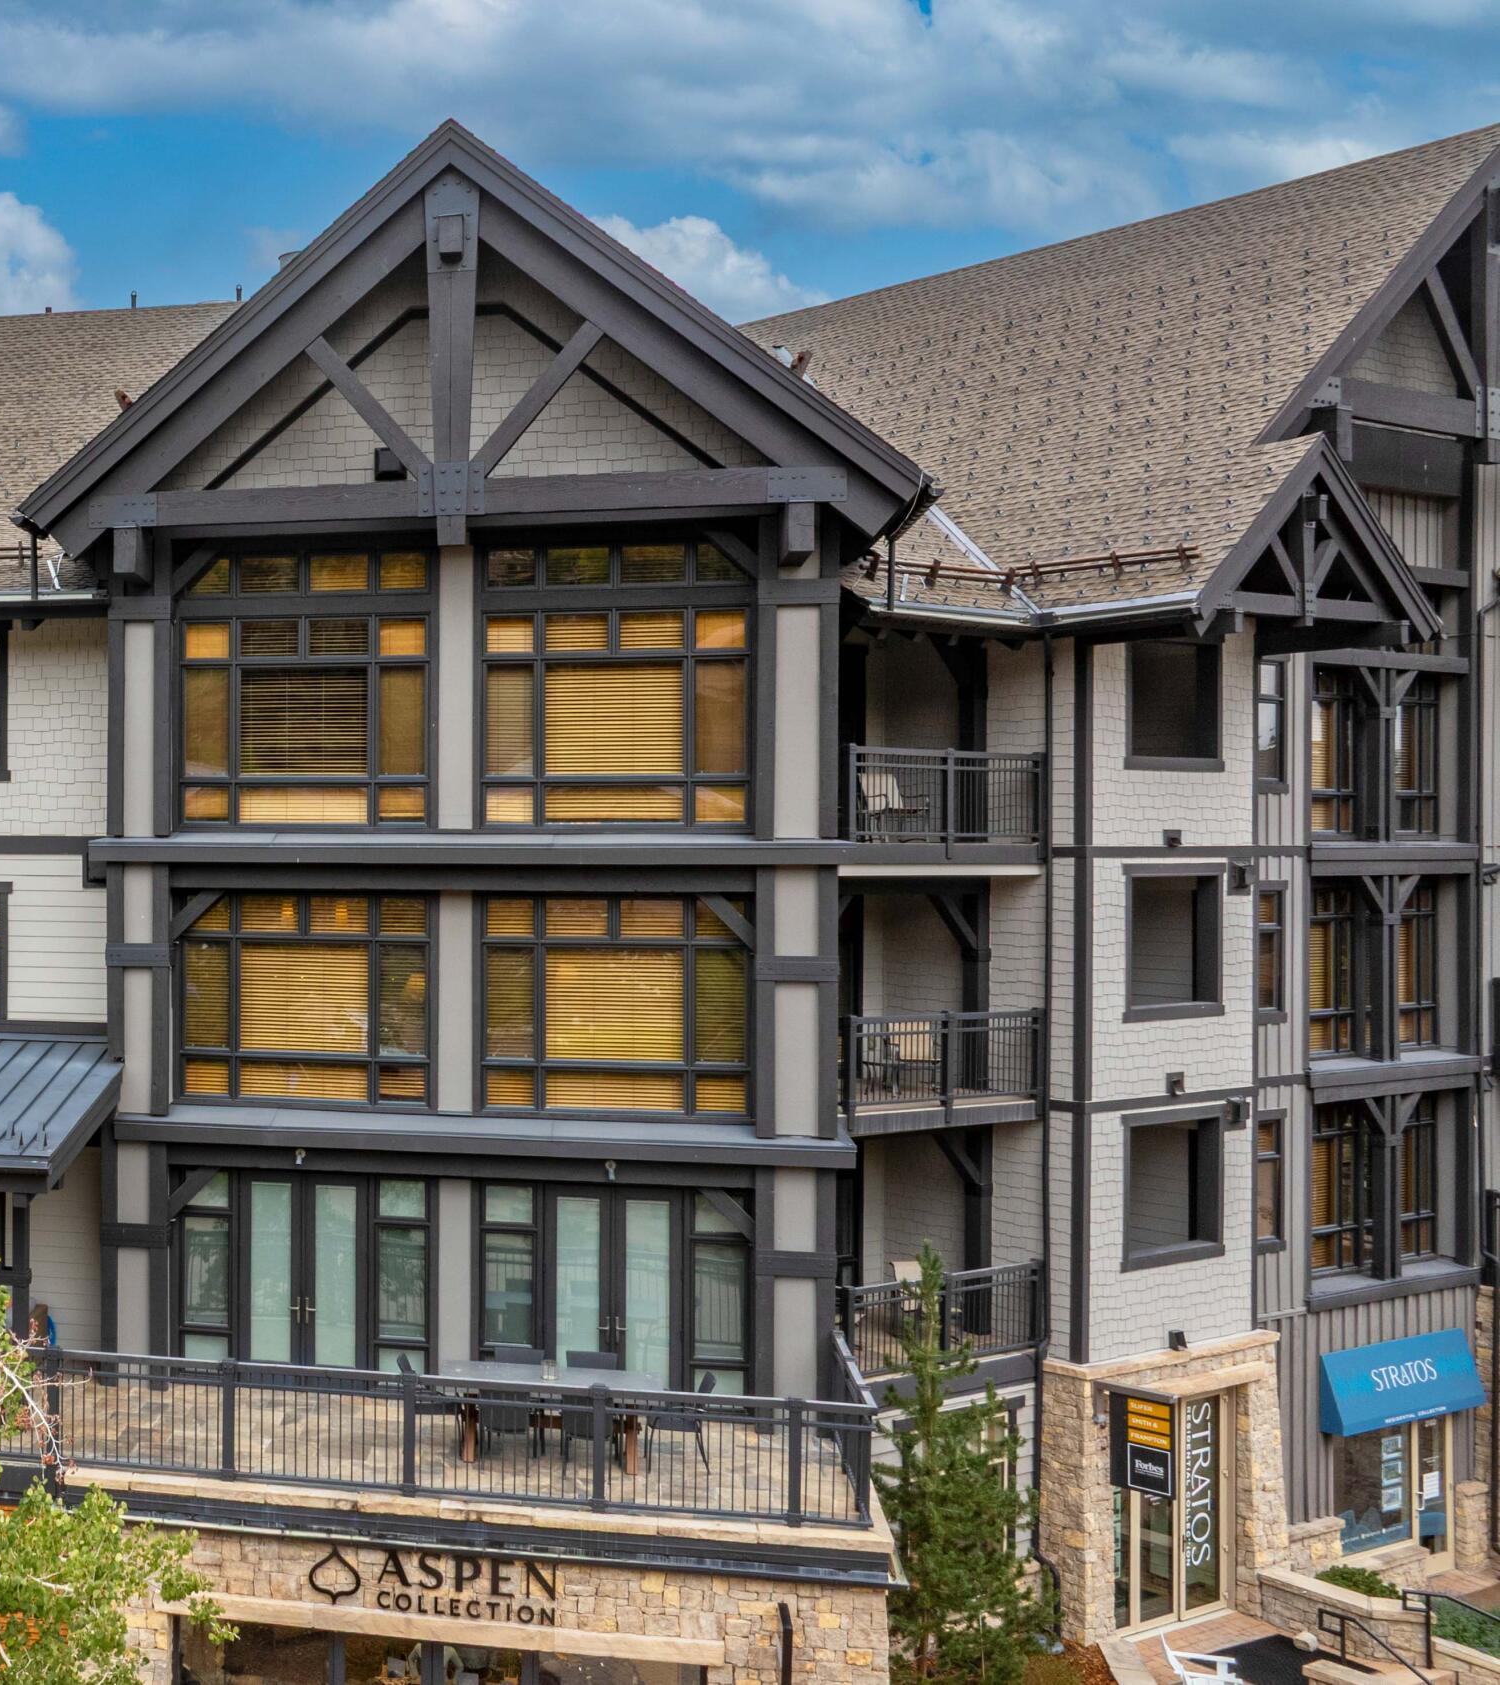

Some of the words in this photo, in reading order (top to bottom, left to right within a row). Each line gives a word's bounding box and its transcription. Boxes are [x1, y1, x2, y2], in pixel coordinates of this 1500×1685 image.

[1371, 1358, 1437, 1391] STRATOS
[1130, 1402, 1152, 1411] SLIFER
[1131, 1417, 1152, 1427] SMITH
[1130, 1432, 1167, 1445] FRAMPTON
[1134, 1459, 1164, 1473] Forbes
[1191, 1402, 1211, 1566] STRATOS
[377, 1550, 557, 1602] ASPEN
[376, 1590, 556, 1627] COLLECTION
